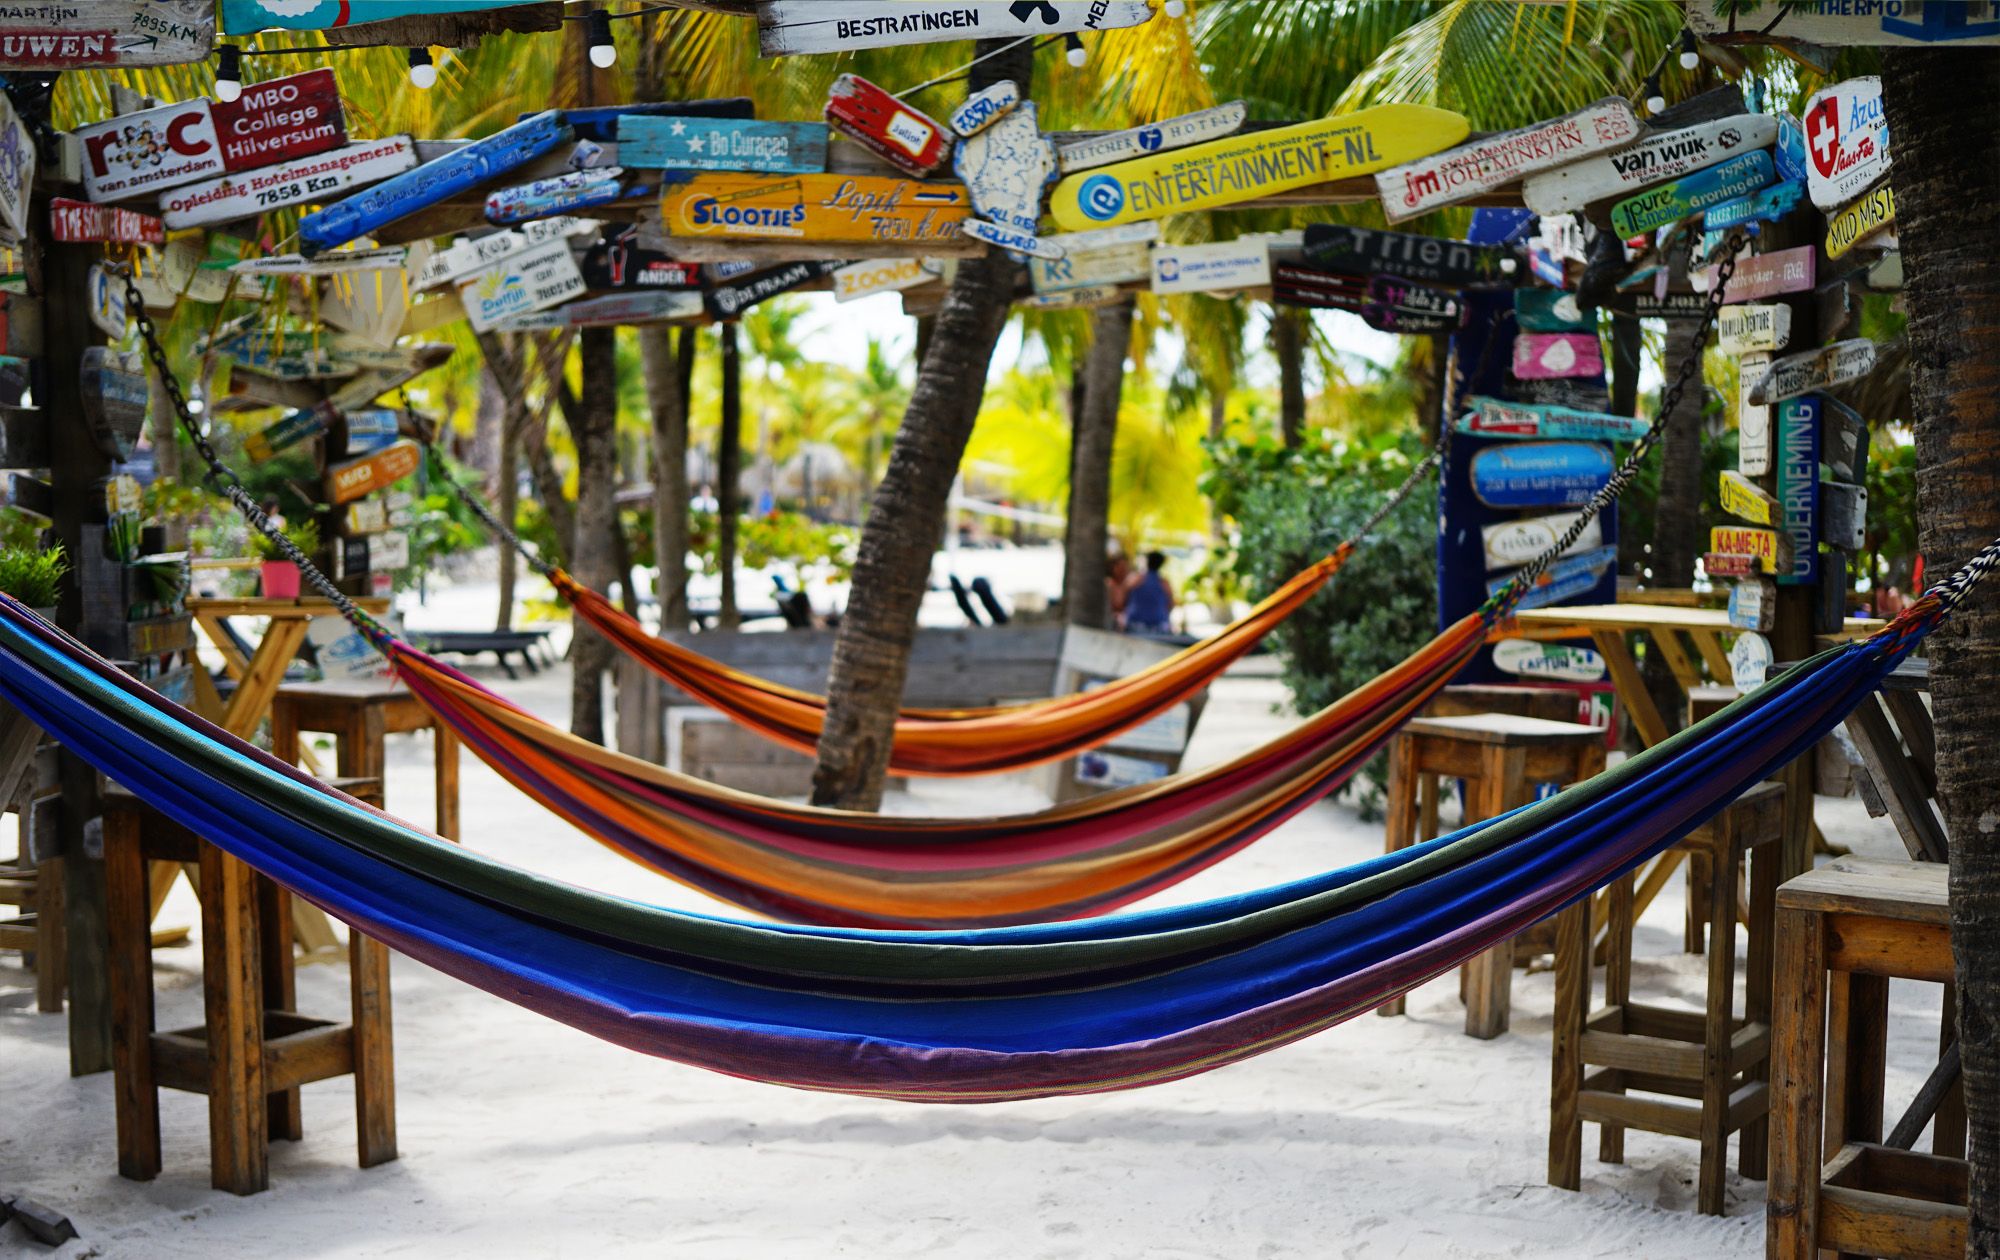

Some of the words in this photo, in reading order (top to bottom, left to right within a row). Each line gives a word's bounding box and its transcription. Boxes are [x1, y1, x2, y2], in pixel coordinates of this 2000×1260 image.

[837, 9, 979, 39] BESTRATINGEN
[243, 84, 299, 112] MBO
[233, 105, 319, 136] College
[226, 123, 336, 160] Hilversum
[710, 131, 729, 156] Bo
[1064, 138, 1134, 163] FLETCHER
[1170, 111, 1240, 138] HOTELS
[129, 158, 217, 187] amsterdam
[251, 140, 406, 191] Hotelmanagement
[1611, 149, 1656, 175] van
[255, 183, 302, 206] 7858
[305, 174, 339, 193] Km
[821, 179, 908, 222] Lopik
[1829, 211, 1857, 251] MUD
